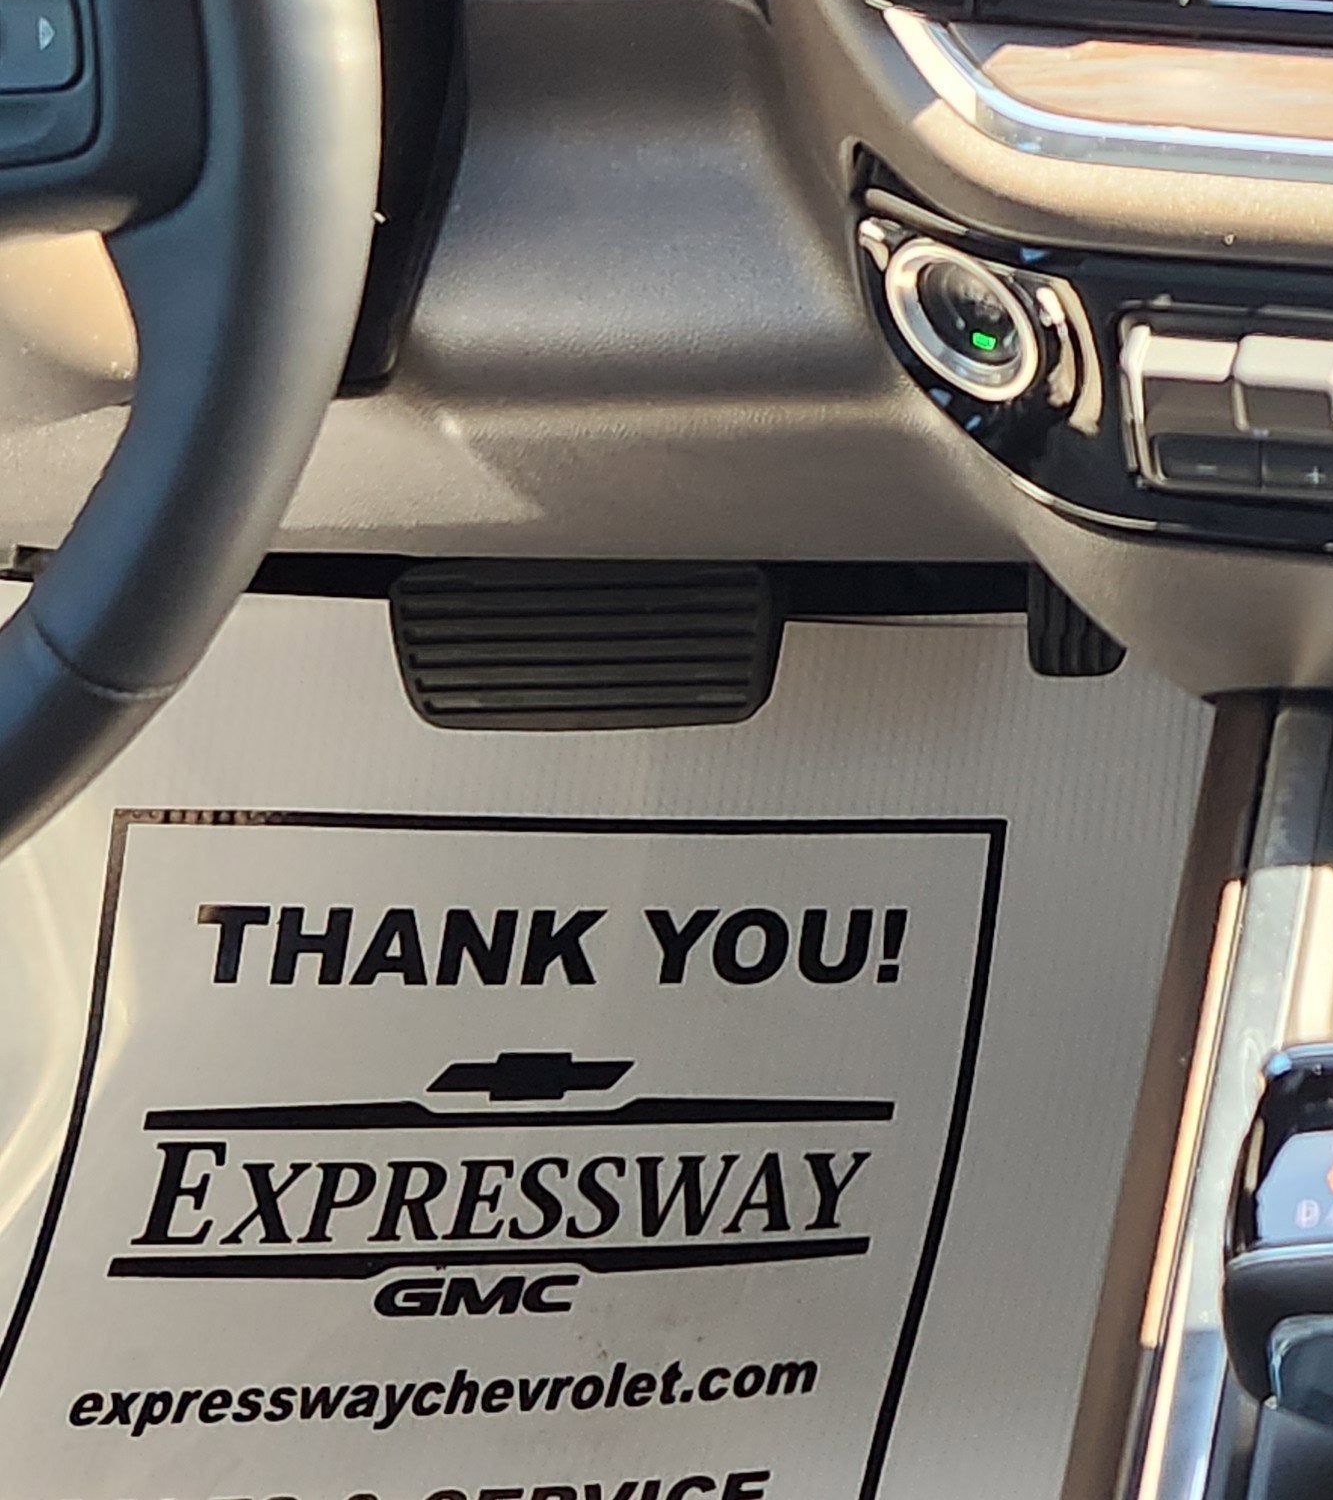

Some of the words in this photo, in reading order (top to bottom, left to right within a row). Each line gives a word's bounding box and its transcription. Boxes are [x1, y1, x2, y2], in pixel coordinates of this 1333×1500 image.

[197, 906, 607, 986] THANK
[646, 908, 908, 986] YOU!
[131, 1141, 871, 1248] EXPRESSWAY
[373, 1274, 579, 1318] GMC
[69, 1361, 818, 1437] expresswaychevrolet.com
